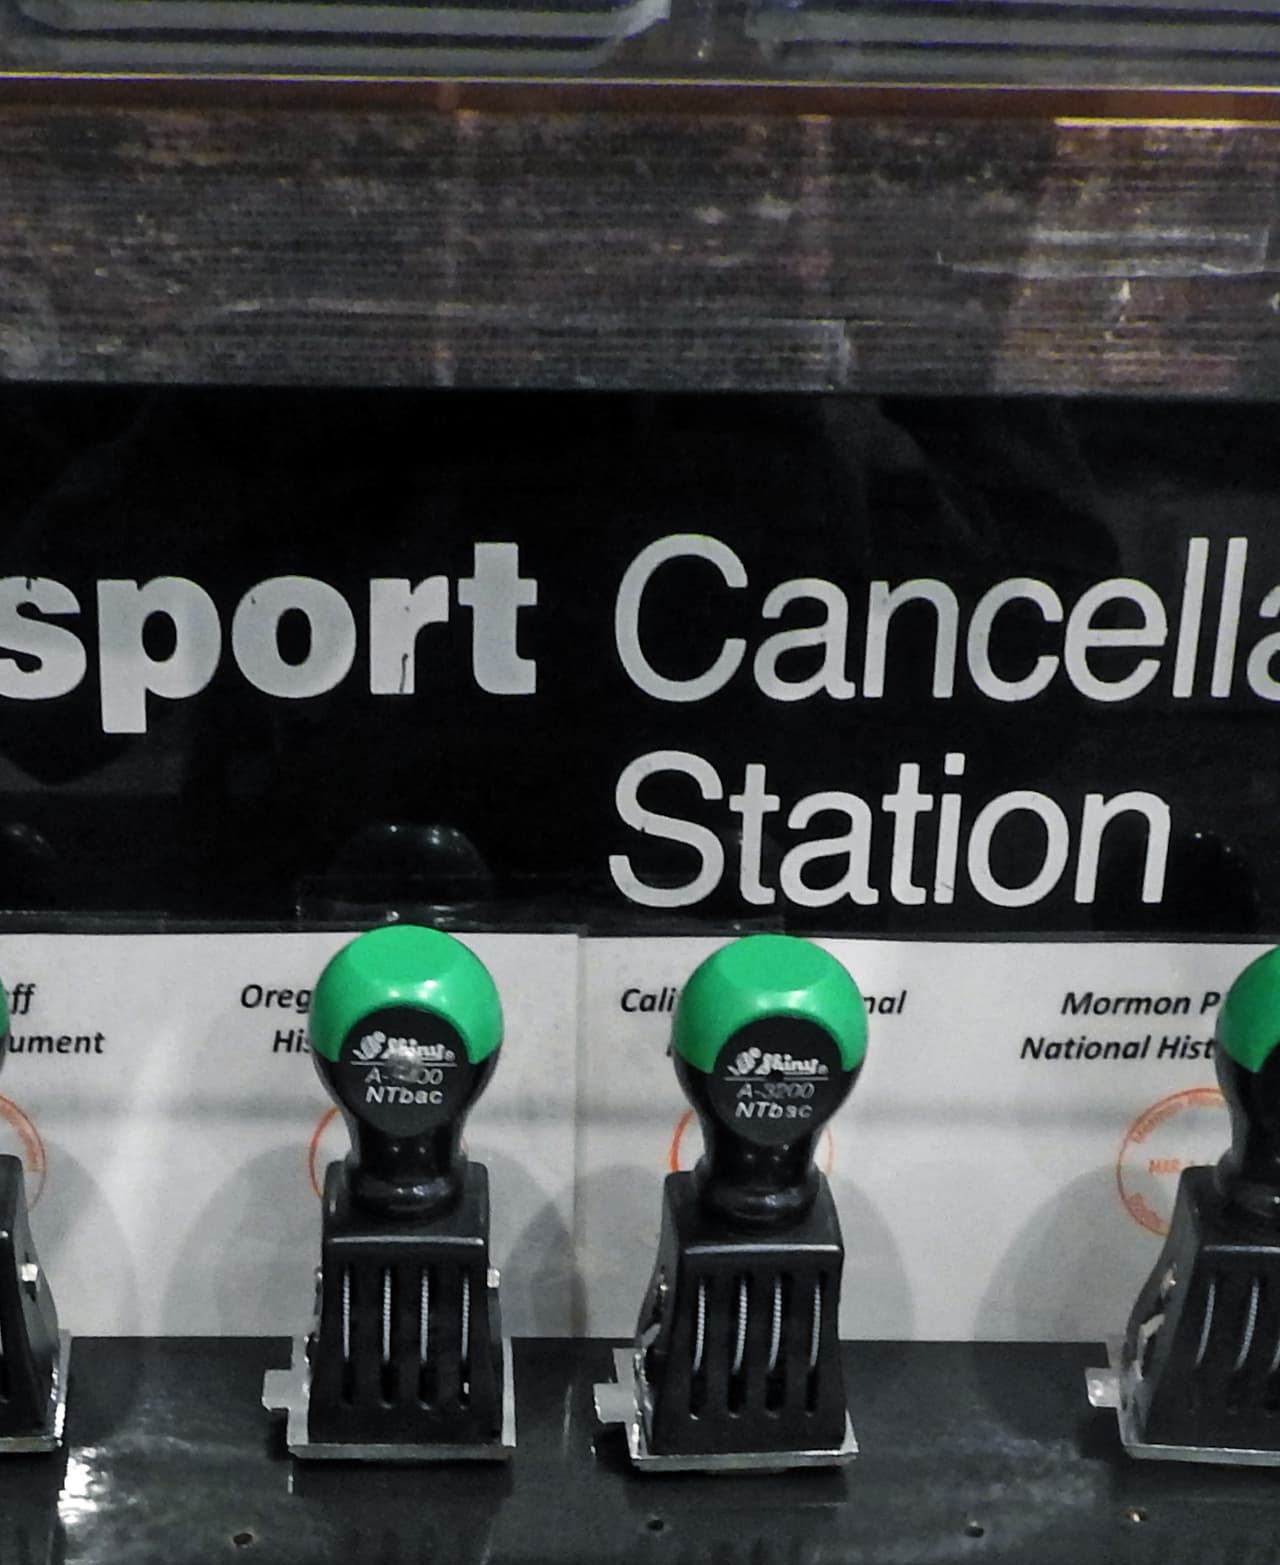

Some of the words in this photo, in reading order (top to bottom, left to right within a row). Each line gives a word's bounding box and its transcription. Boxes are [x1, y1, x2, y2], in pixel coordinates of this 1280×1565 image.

[608, 750, 1171, 907] Station
[240, 984, 313, 1014] Oreg
[1061, 991, 1190, 1016] Mormon
[9, 1032, 105, 1054] ument
[1020, 1036, 1152, 1060] National
[1157, 1036, 1217, 1060] Hist
[365, 1067, 444, 1085] A-00
